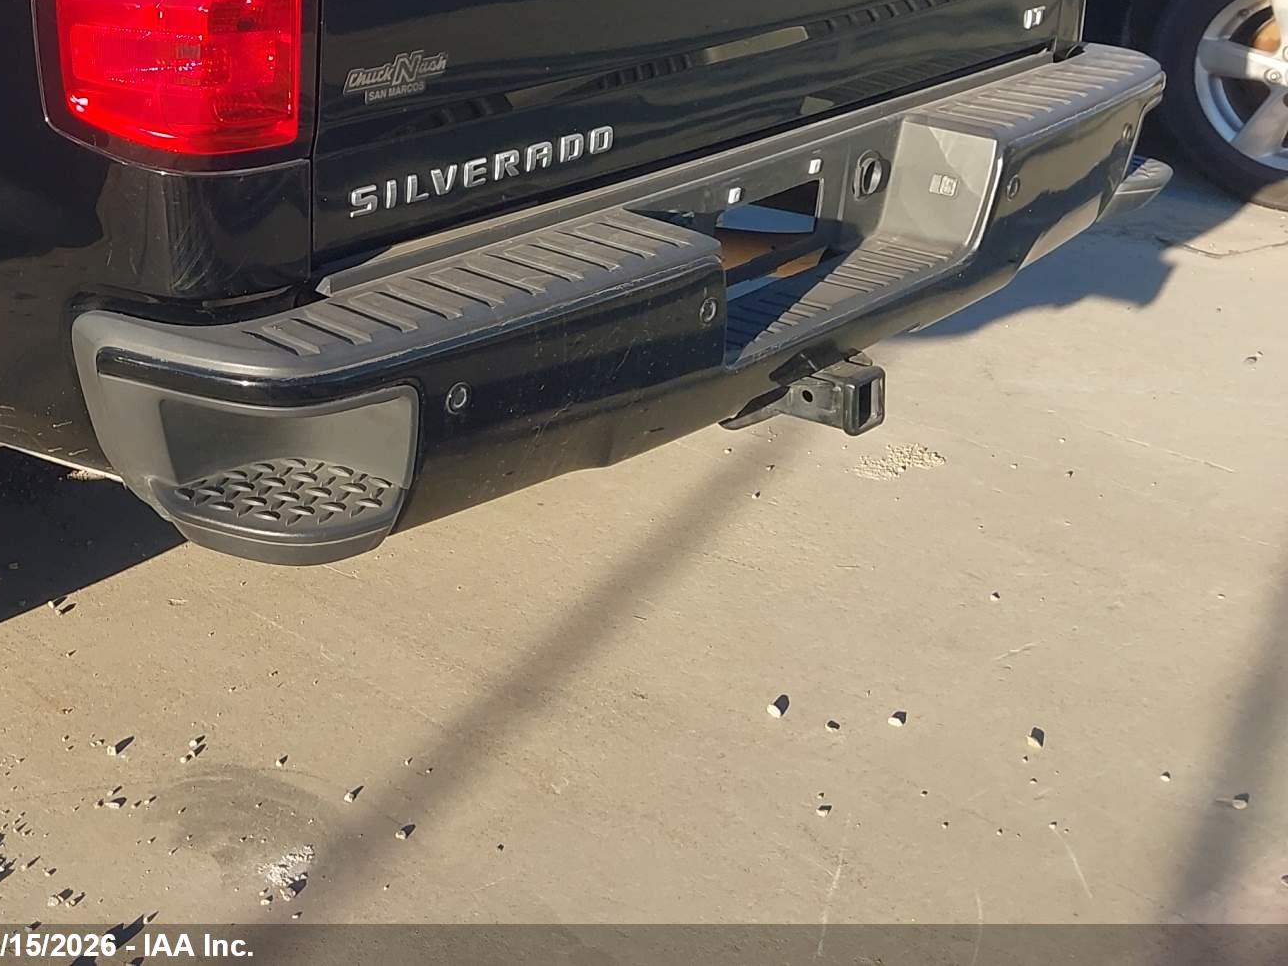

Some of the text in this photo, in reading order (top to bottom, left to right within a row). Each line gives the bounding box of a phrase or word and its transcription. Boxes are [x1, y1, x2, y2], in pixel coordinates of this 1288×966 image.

[1023, 5, 1046, 30] LT
[348, 53, 447, 89] Chuck Nash
[368, 81, 426, 102] SAN MARCOS
[349, 125, 614, 219] SILVERADO
